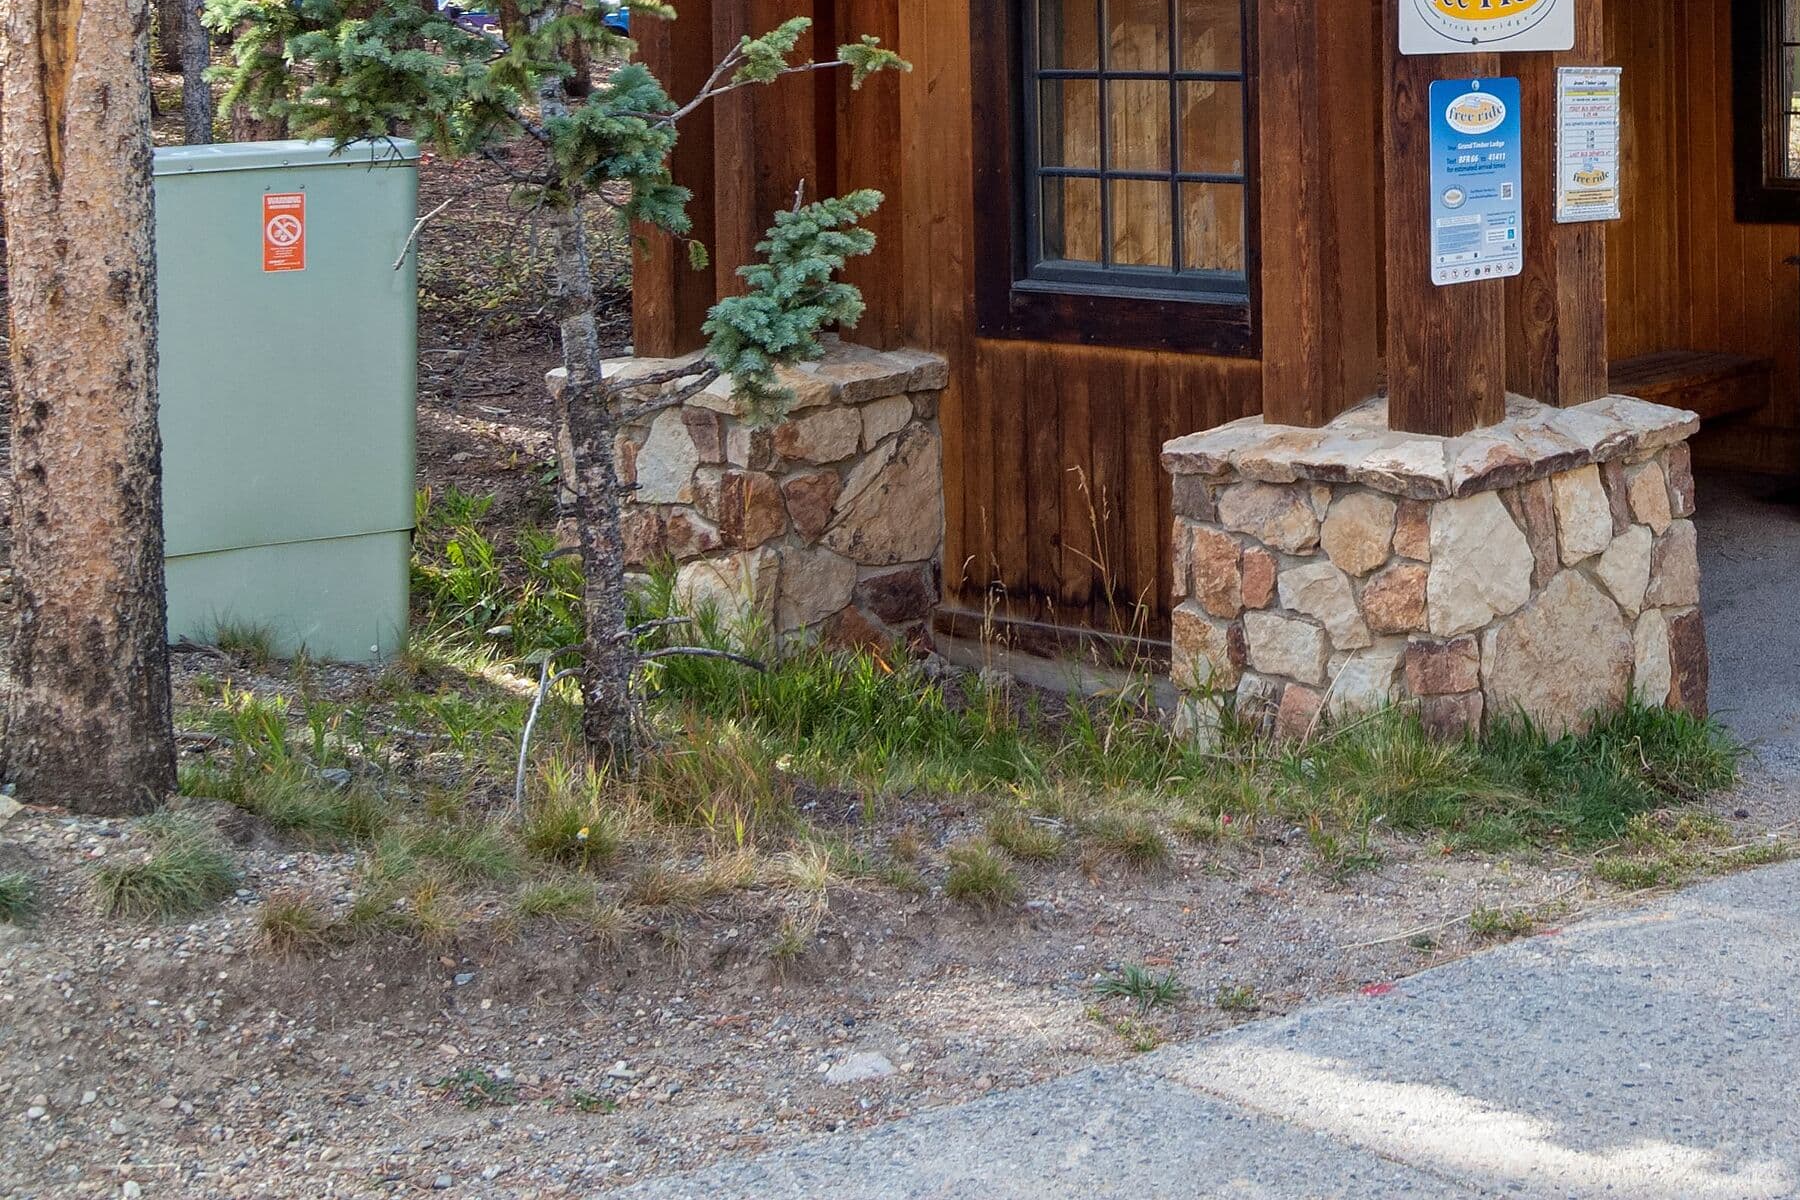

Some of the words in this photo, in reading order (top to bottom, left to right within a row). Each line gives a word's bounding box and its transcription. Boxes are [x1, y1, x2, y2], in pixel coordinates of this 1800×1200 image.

[1442, 15, 1530, 32] breckenridge
[1449, 107, 1474, 121] free
[1478, 104, 1503, 121] ride
[1457, 142, 1473, 150] Grand
[1473, 141, 1489, 149] Timber
[1490, 140, 1504, 149] Lodge
[1488, 152, 1505, 161] 41411
[1573, 172, 1590, 183] free
[1592, 171, 1610, 183] ride
